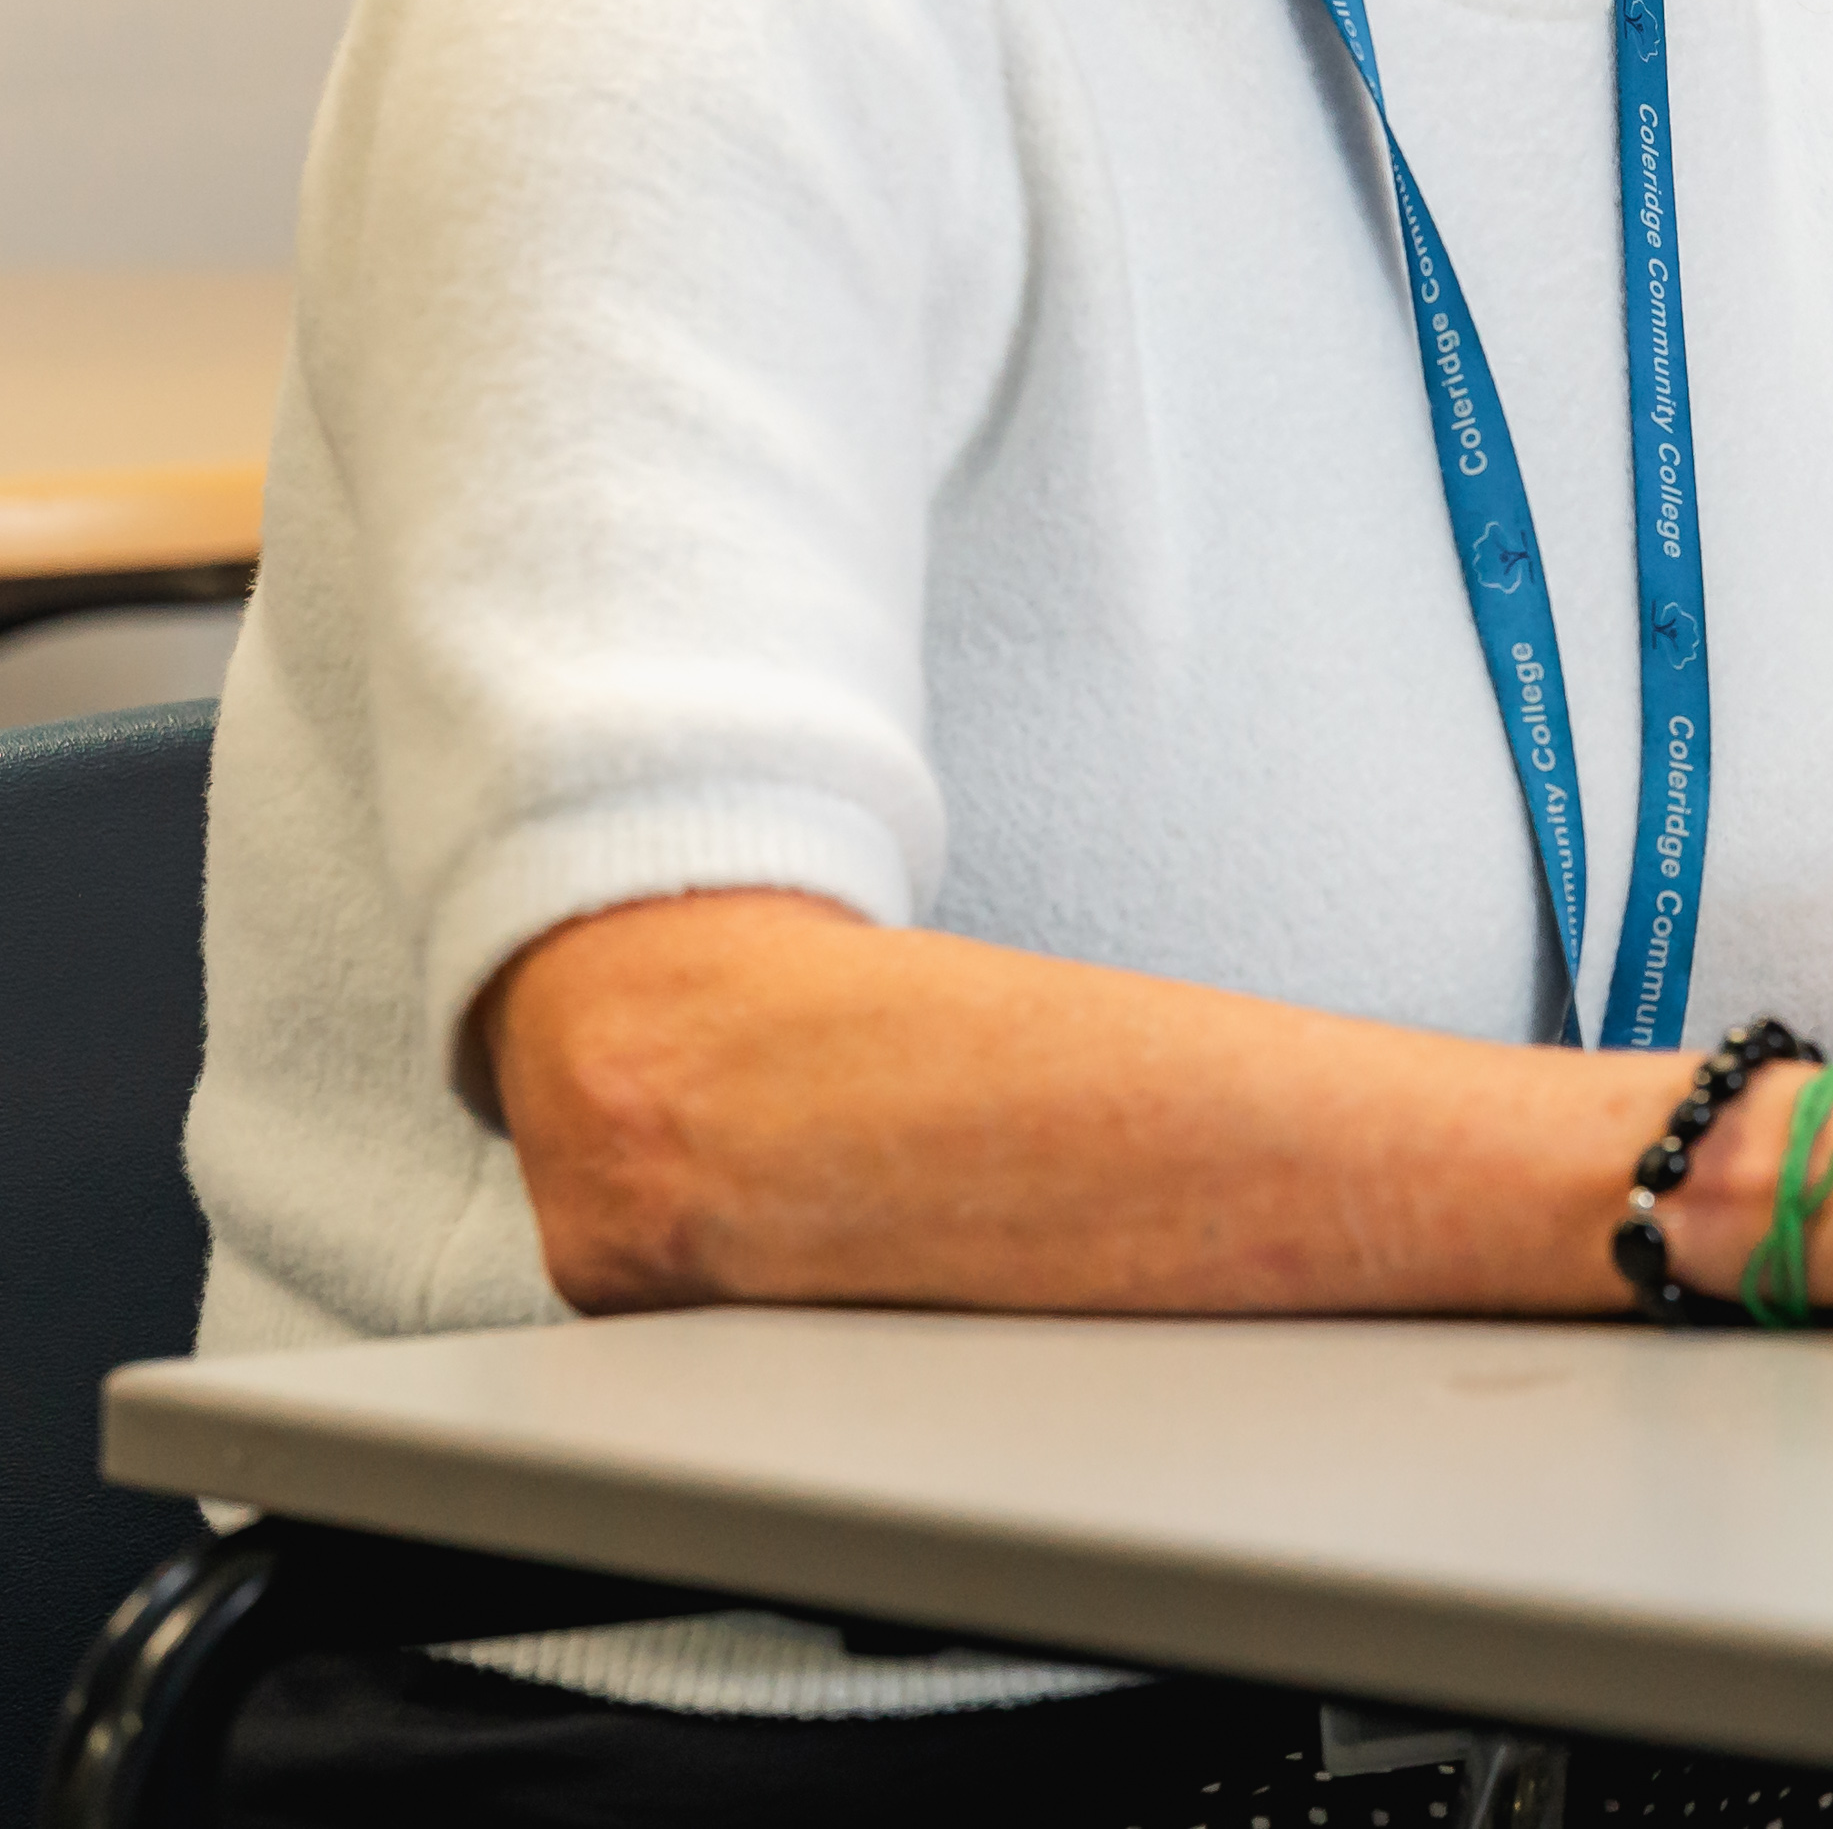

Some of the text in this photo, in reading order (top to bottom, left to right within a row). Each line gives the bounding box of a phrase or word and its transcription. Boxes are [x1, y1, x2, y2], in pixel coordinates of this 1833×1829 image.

[1431, 311, 1489, 477] Coleridge
[1637, 101, 1682, 559] Coleridge Community College
[1511, 641, 1557, 773] College
[1630, 714, 1695, 1047] Coleridge Commun
